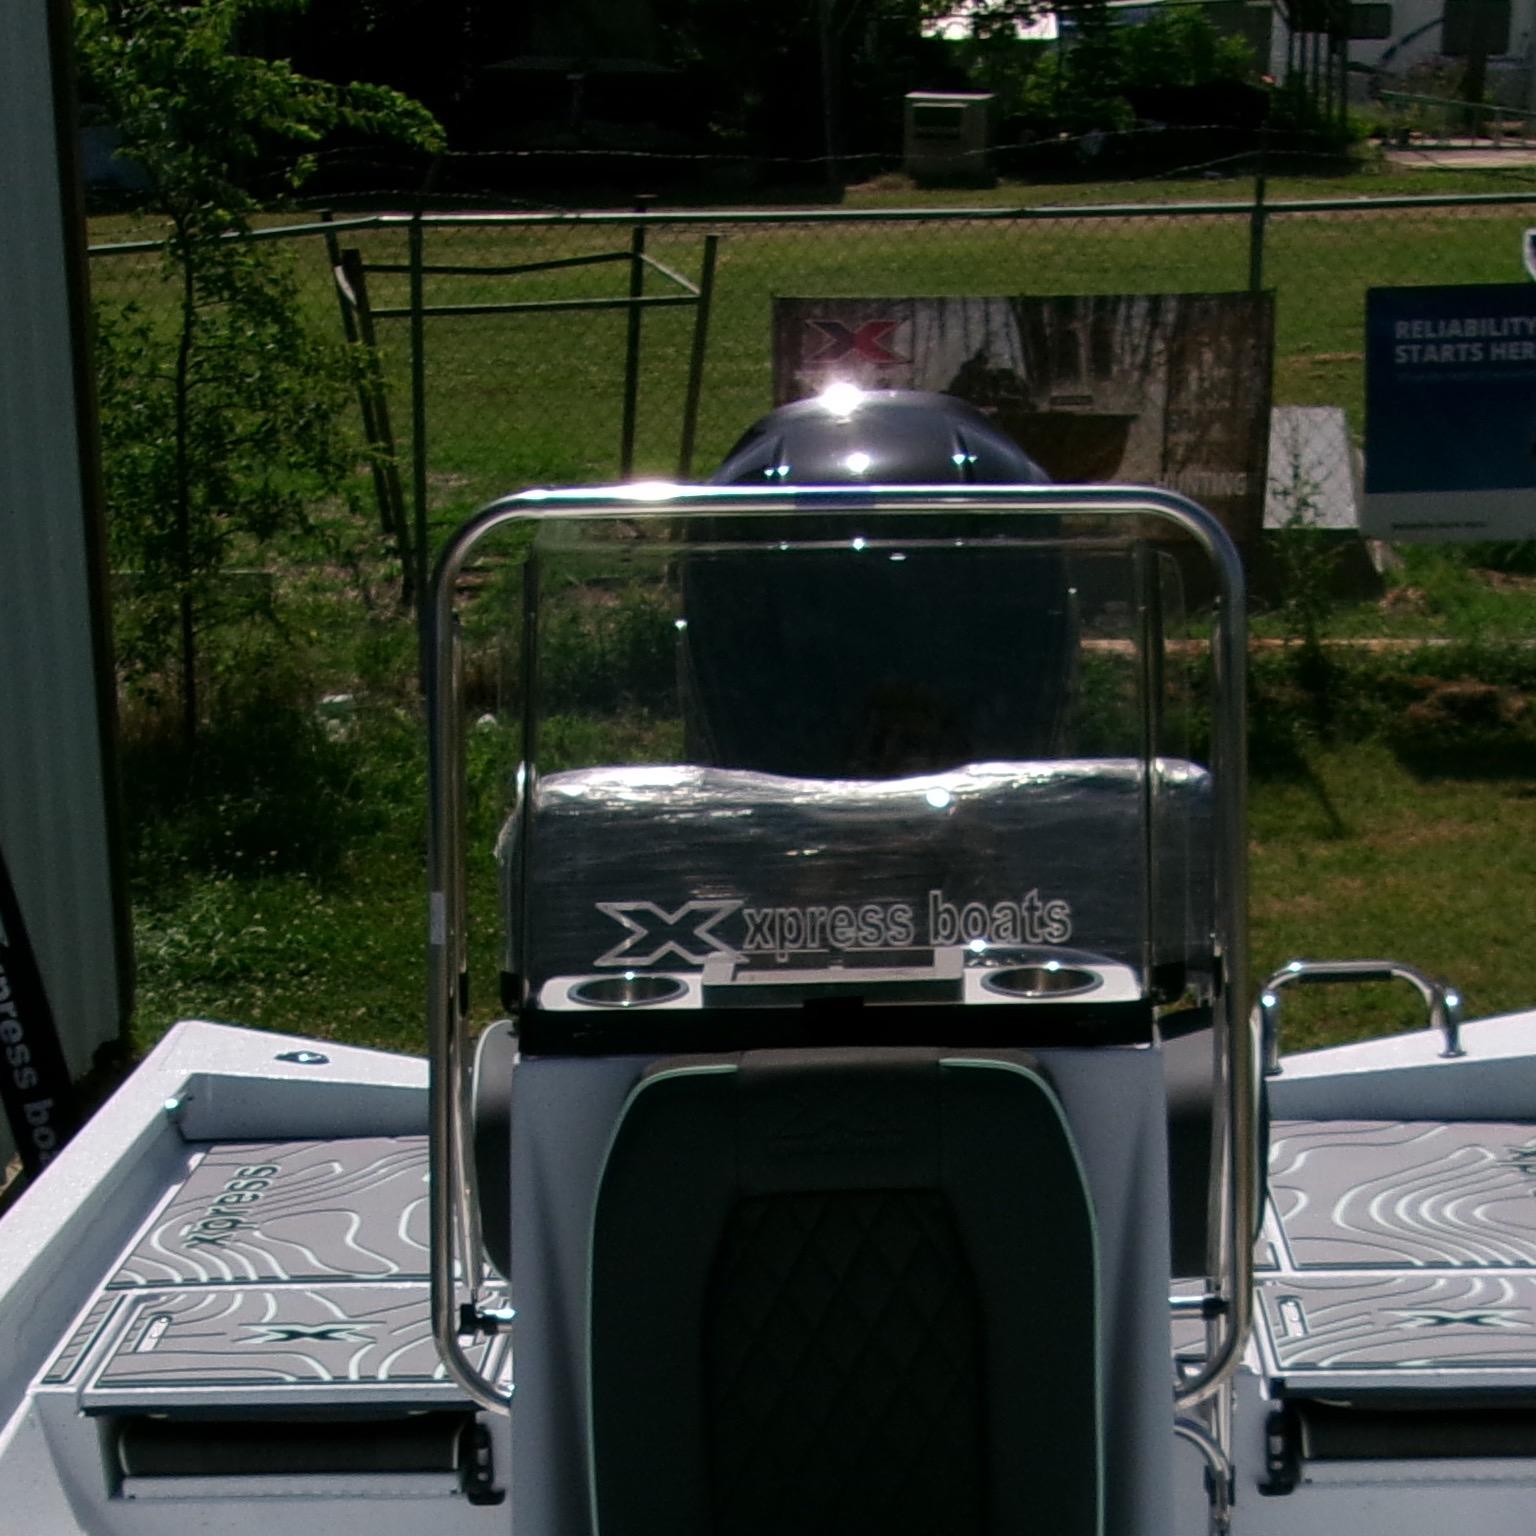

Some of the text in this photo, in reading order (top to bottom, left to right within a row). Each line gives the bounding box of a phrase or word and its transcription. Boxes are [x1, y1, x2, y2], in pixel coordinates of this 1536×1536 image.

[1394, 343, 1484, 364] STARTS
[745, 897, 915, 962] xpress
[929, 889, 1073, 944] boats
[179, 1162, 281, 1249] xpress
